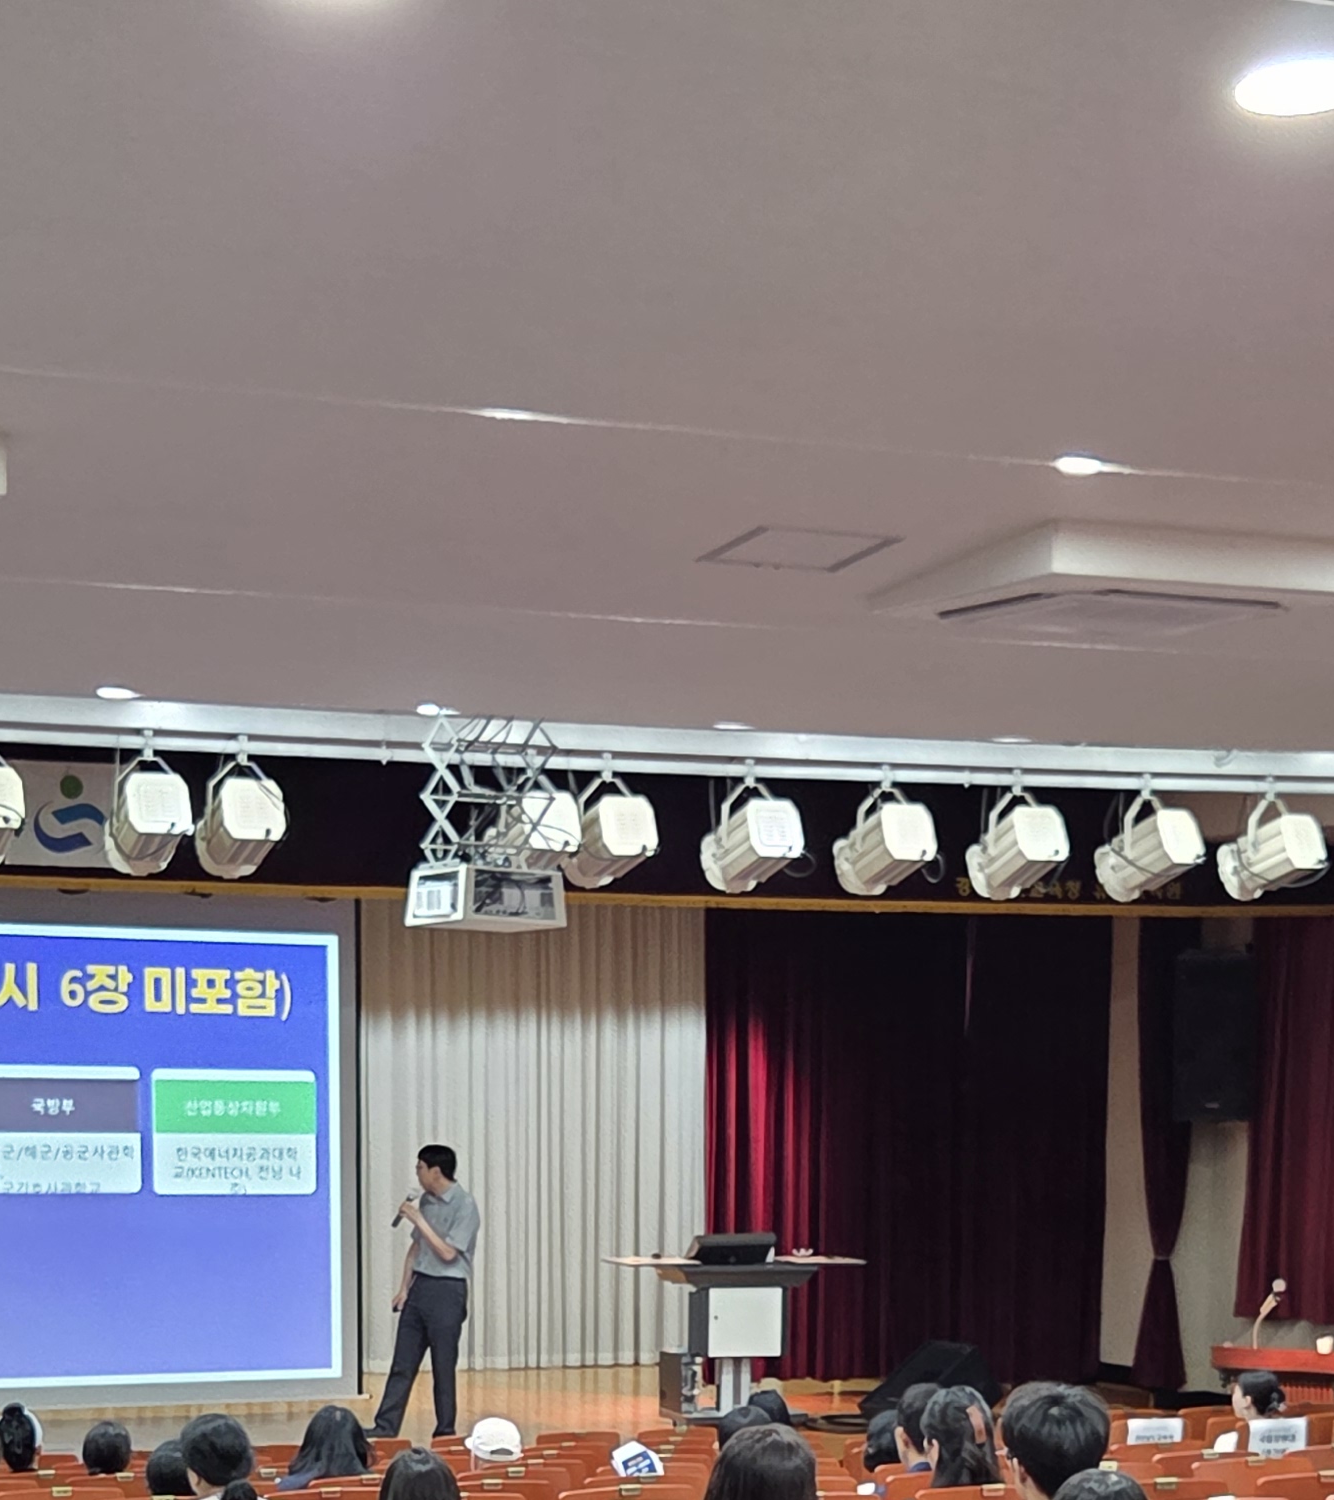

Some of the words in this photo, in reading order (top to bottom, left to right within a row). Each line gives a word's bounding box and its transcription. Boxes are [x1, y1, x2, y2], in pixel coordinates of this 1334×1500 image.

[60, 964, 134, 1014] 6장
[144, 967, 292, 1021] 미포함)
[30, 1098, 75, 1116] 국방부
